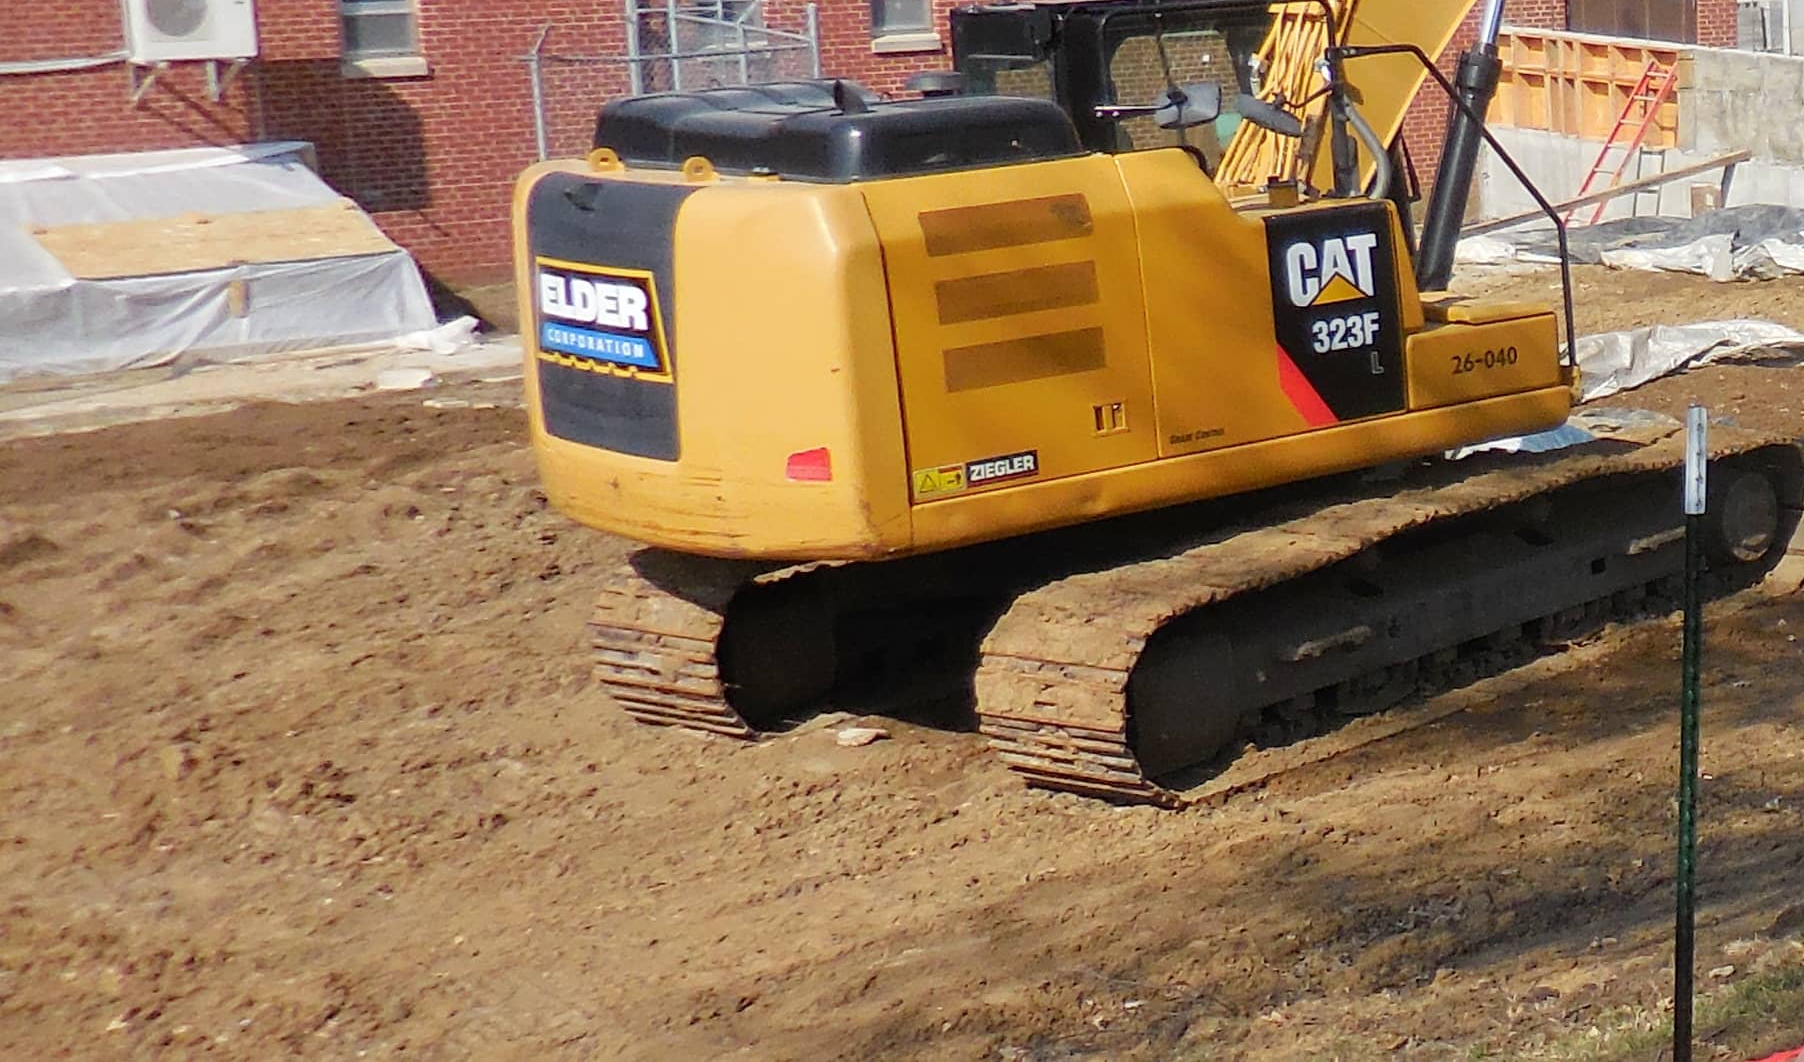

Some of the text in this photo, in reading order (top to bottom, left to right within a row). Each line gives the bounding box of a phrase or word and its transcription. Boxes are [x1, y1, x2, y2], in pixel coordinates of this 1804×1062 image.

[1286, 233, 1378, 307] CAT
[540, 273, 649, 331] ELDER
[547, 328, 645, 359] CORPORATION
[1312, 312, 1380, 354] 323F
[1371, 351, 1385, 375] L
[1451, 346, 1518, 375] 26-040
[969, 455, 1035, 482] ZIEGLER
